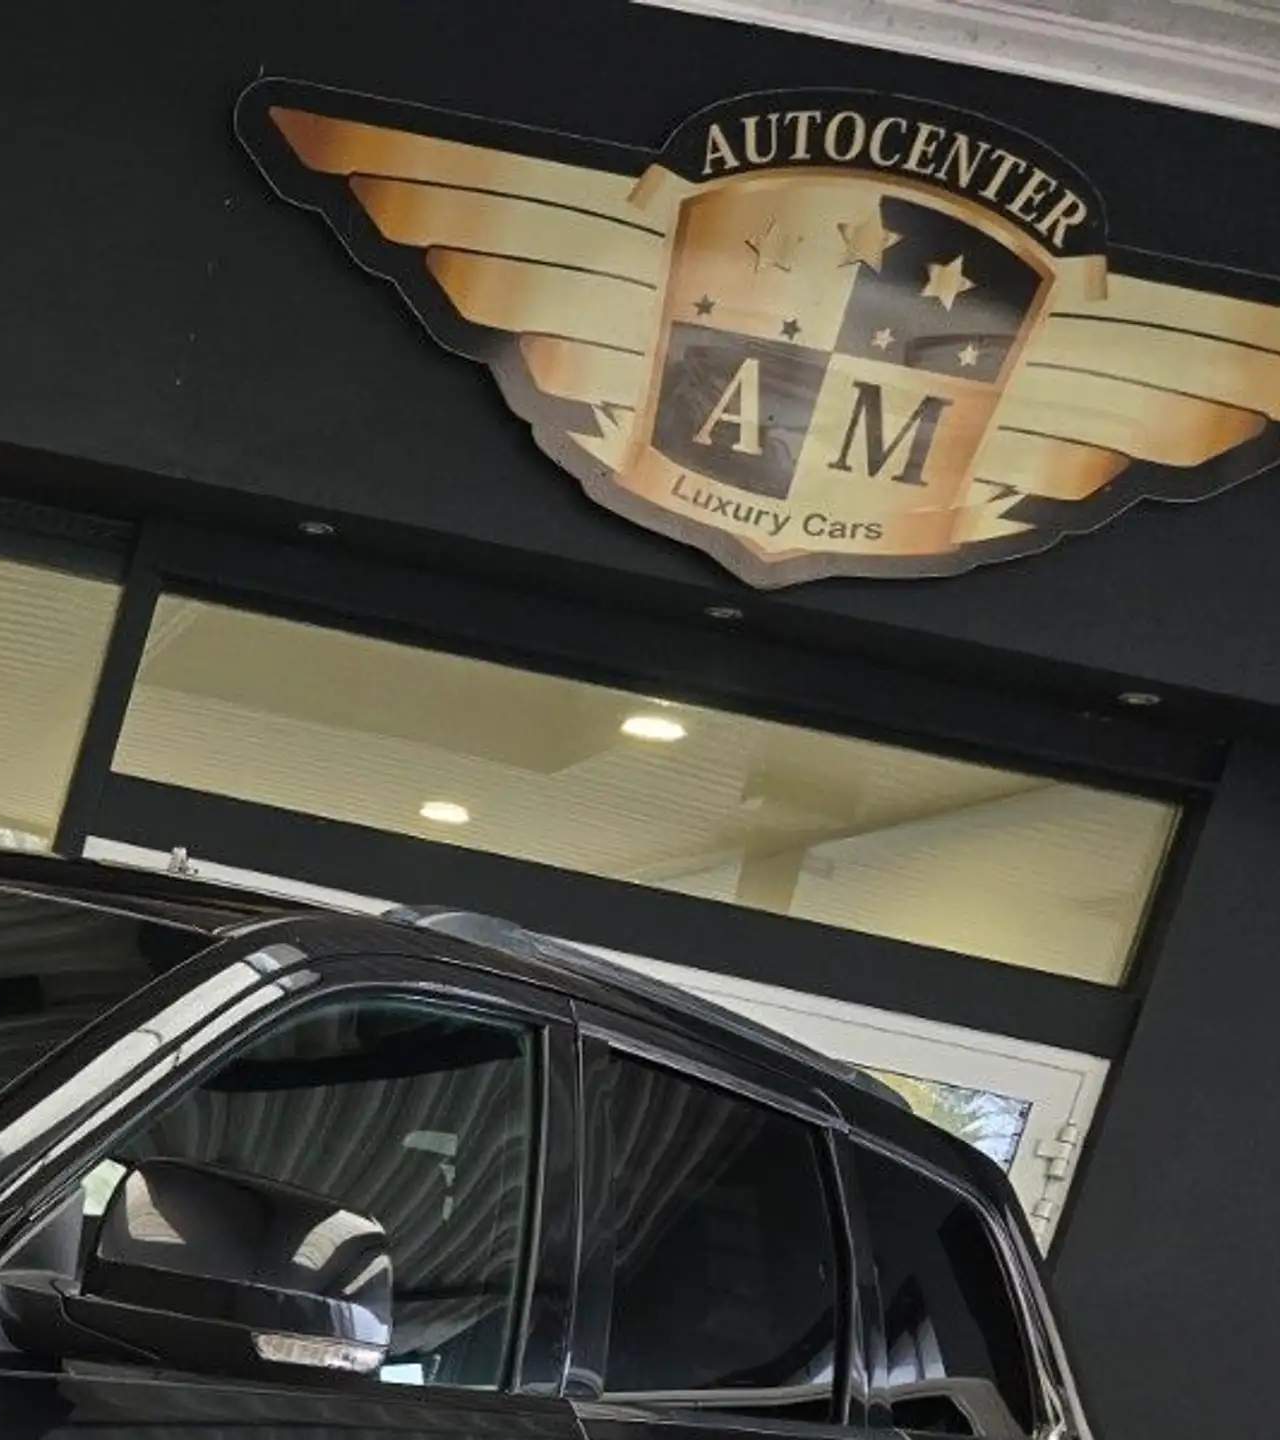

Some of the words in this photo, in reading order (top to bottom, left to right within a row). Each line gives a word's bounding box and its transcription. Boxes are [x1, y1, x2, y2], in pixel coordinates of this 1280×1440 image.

[700, 109, 1089, 249] AUTOCENTER
[692, 357, 764, 456] A
[827, 379, 956, 487] M
[669, 474, 792, 537] Luxury
[801, 512, 885, 542] Cars
